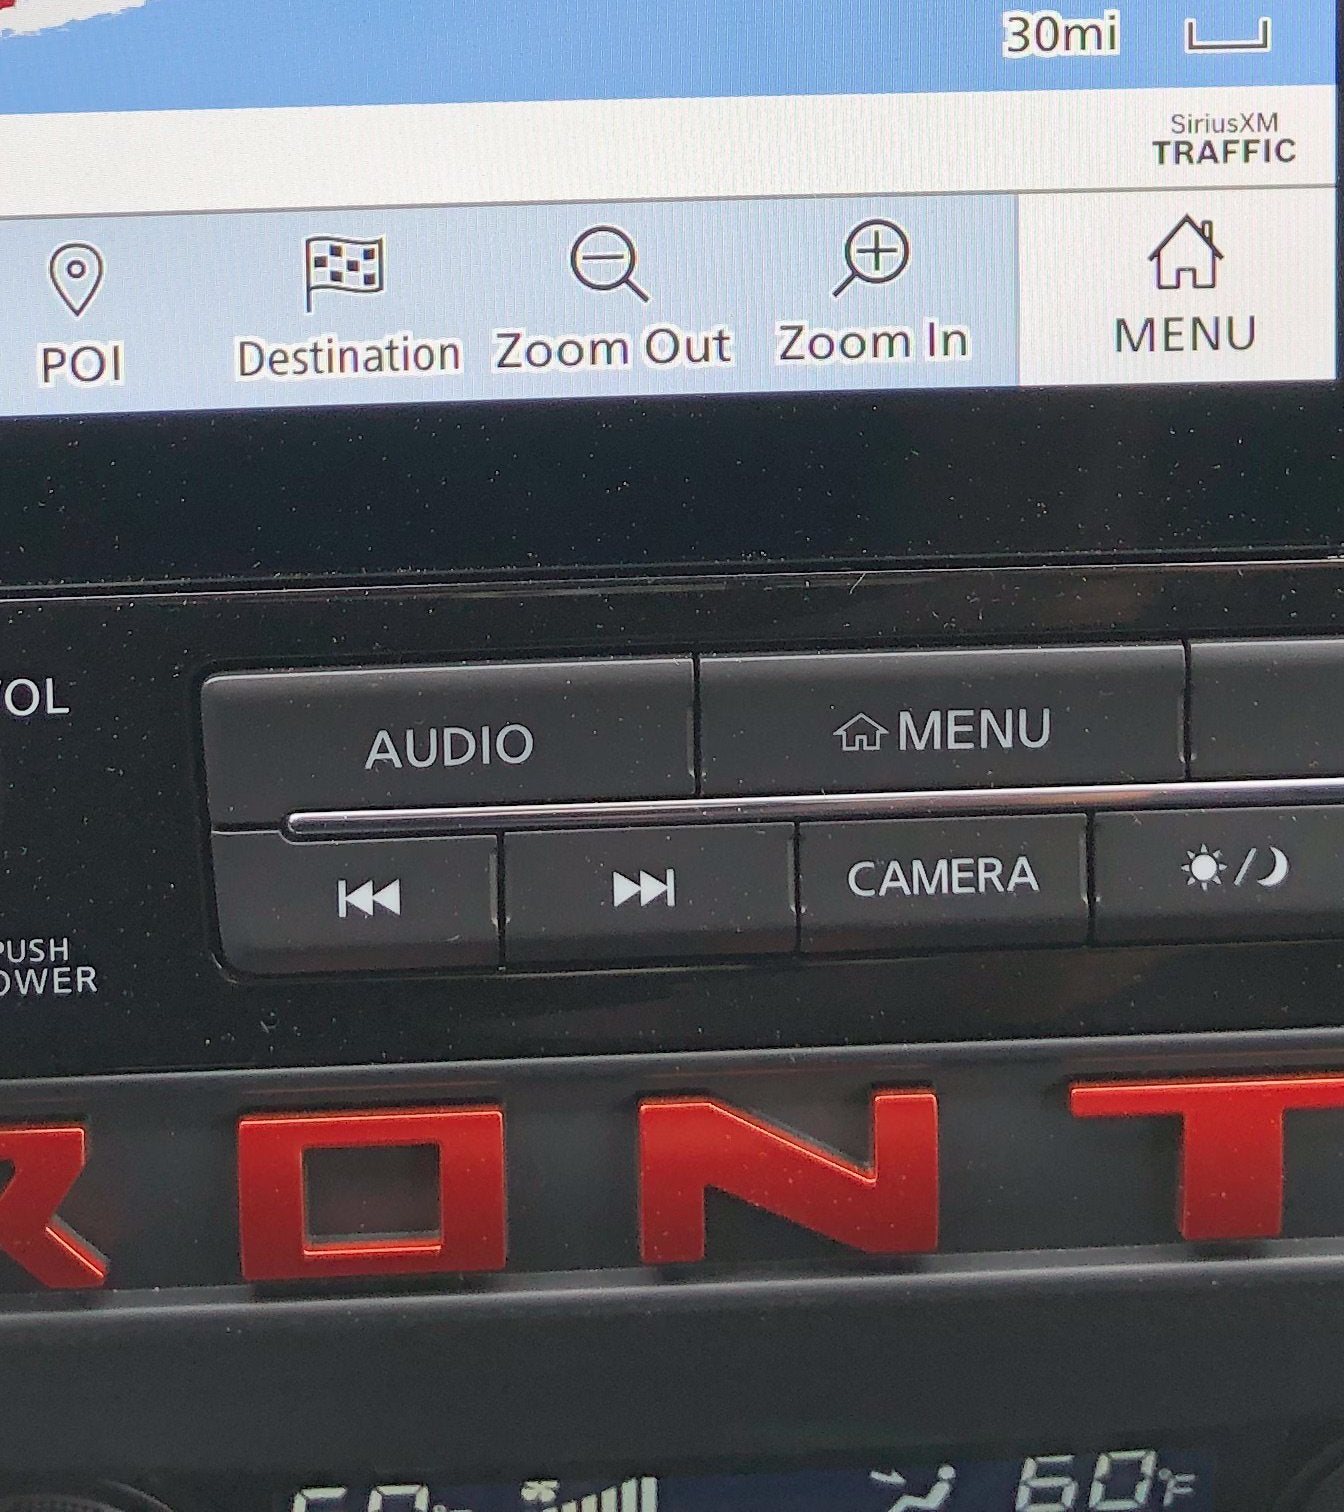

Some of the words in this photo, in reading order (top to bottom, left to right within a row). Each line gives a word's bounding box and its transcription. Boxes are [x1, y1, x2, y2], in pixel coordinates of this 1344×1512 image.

[1006, 14, 1118, 53] 30mi
[1170, 111, 1279, 136] SiriusXM
[1152, 138, 1297, 166] TRAFFIC
[496, 331, 629, 369] Zoom
[644, 326, 731, 364] Out
[780, 323, 911, 361] Zoom
[928, 321, 968, 358] In
[1115, 314, 1257, 355] MENU
[42, 344, 121, 384] POI
[239, 334, 460, 378] Destination
[364, 724, 534, 770] AUDIO
[898, 708, 1052, 752] MENU
[847, 855, 1040, 898] CAMERA
